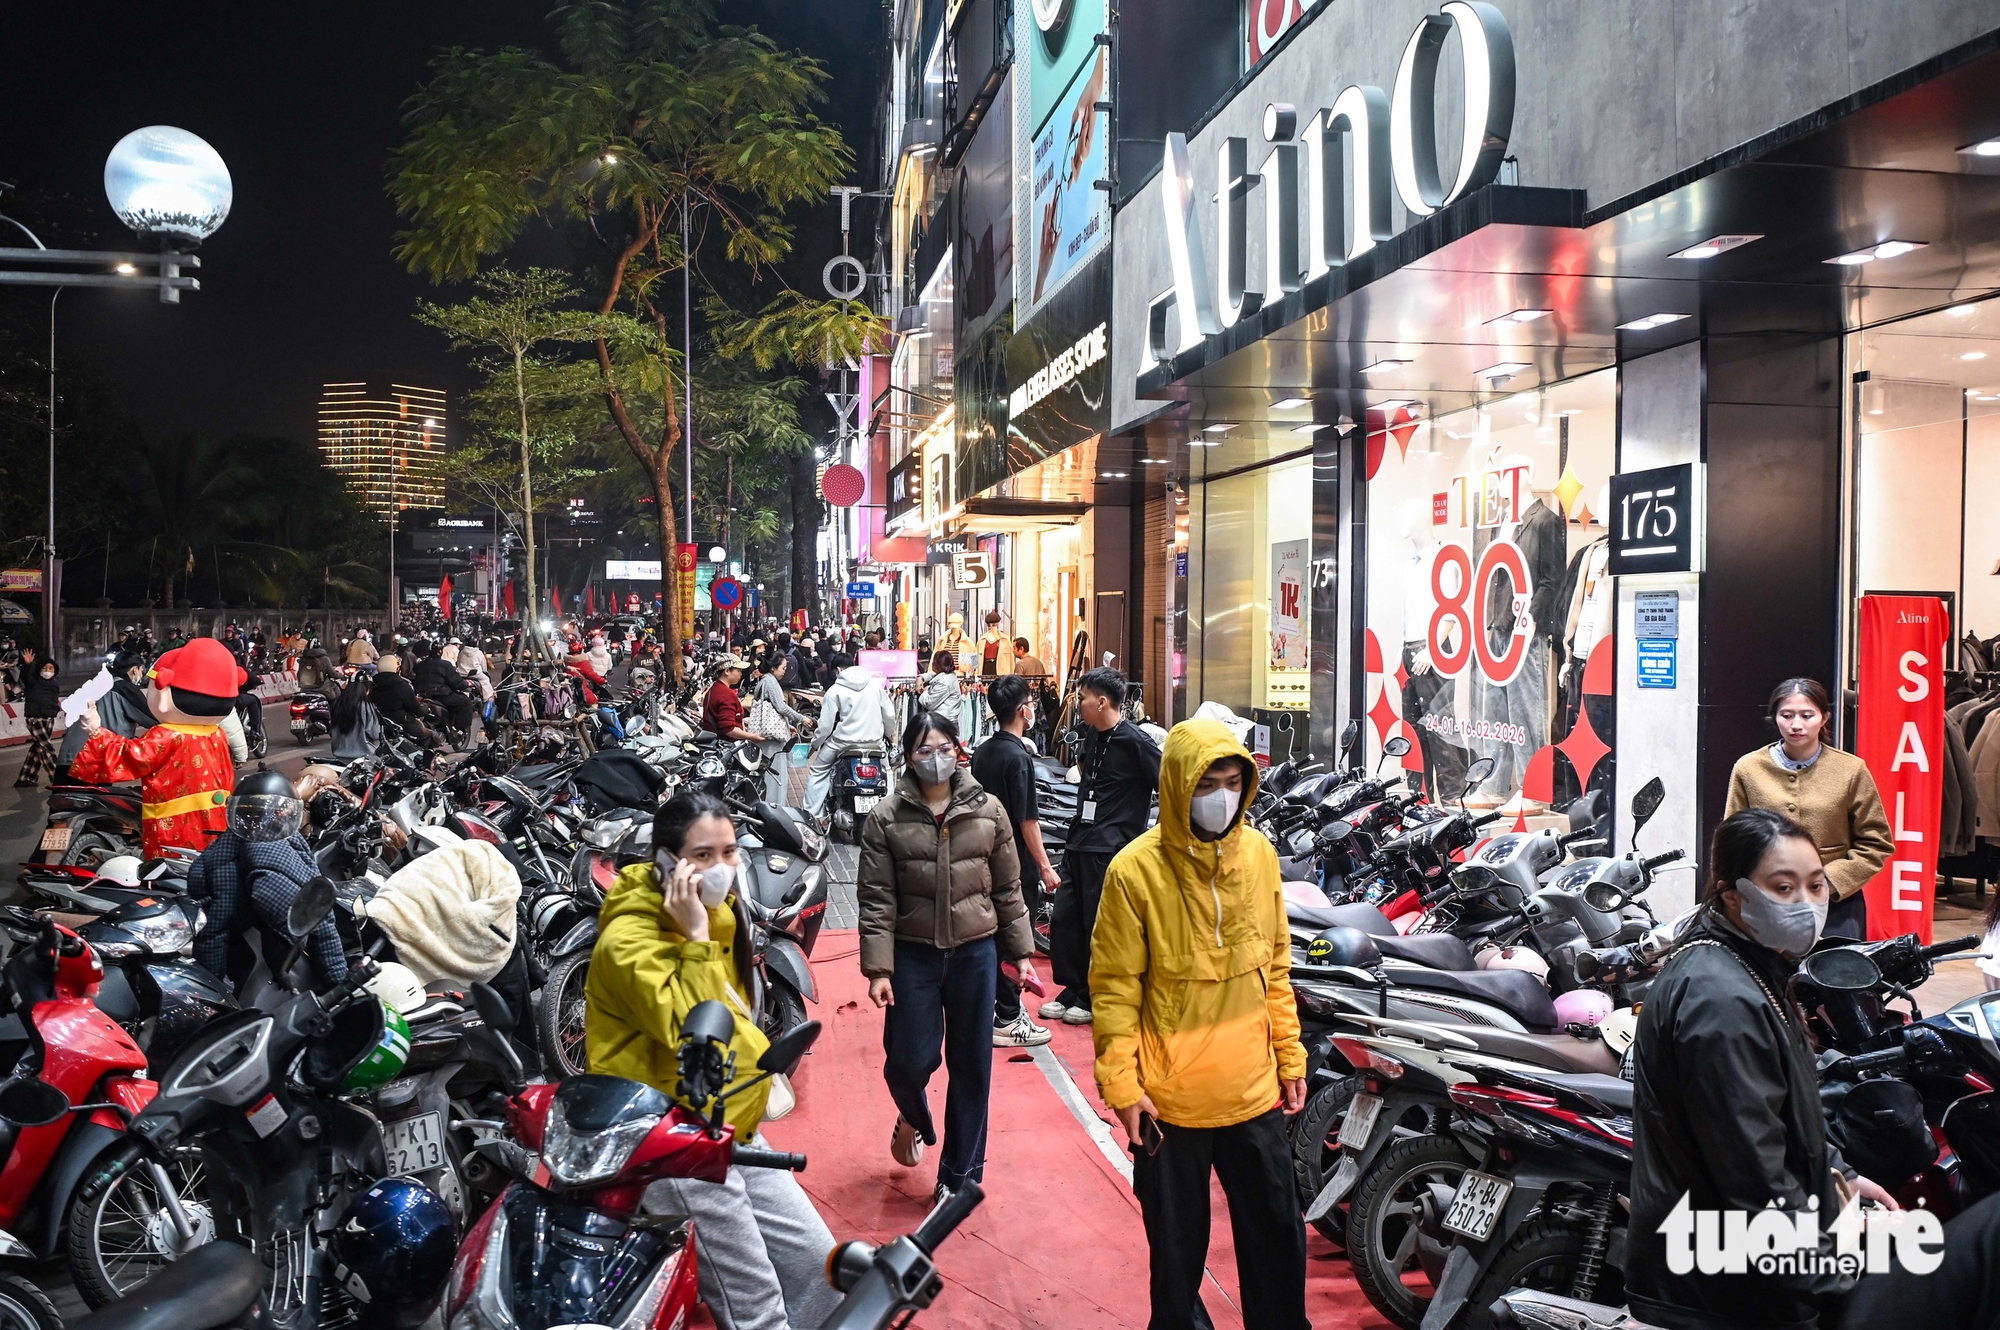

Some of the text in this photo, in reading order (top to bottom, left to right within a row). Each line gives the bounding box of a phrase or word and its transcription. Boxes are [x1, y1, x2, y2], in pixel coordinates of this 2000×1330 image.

[1137, 1, 1515, 377] Atino
[1027, 347, 1074, 408] EYEGLASSES
[1075, 321, 1107, 374] STORE
[1452, 446, 1530, 528] TẾT
[1621, 486, 1677, 540] 175
[935, 543, 966, 553] KRIK
[964, 556, 987, 584] 5
[1307, 559, 1329, 588] 173
[1281, 582, 1299, 619] 1K
[1897, 610, 1930, 624] Atino
[1897, 650, 1930, 913] SALE
[1462, 1176, 1502, 1209] 34-B4
[1445, 1200, 1495, 1237] 250.29
